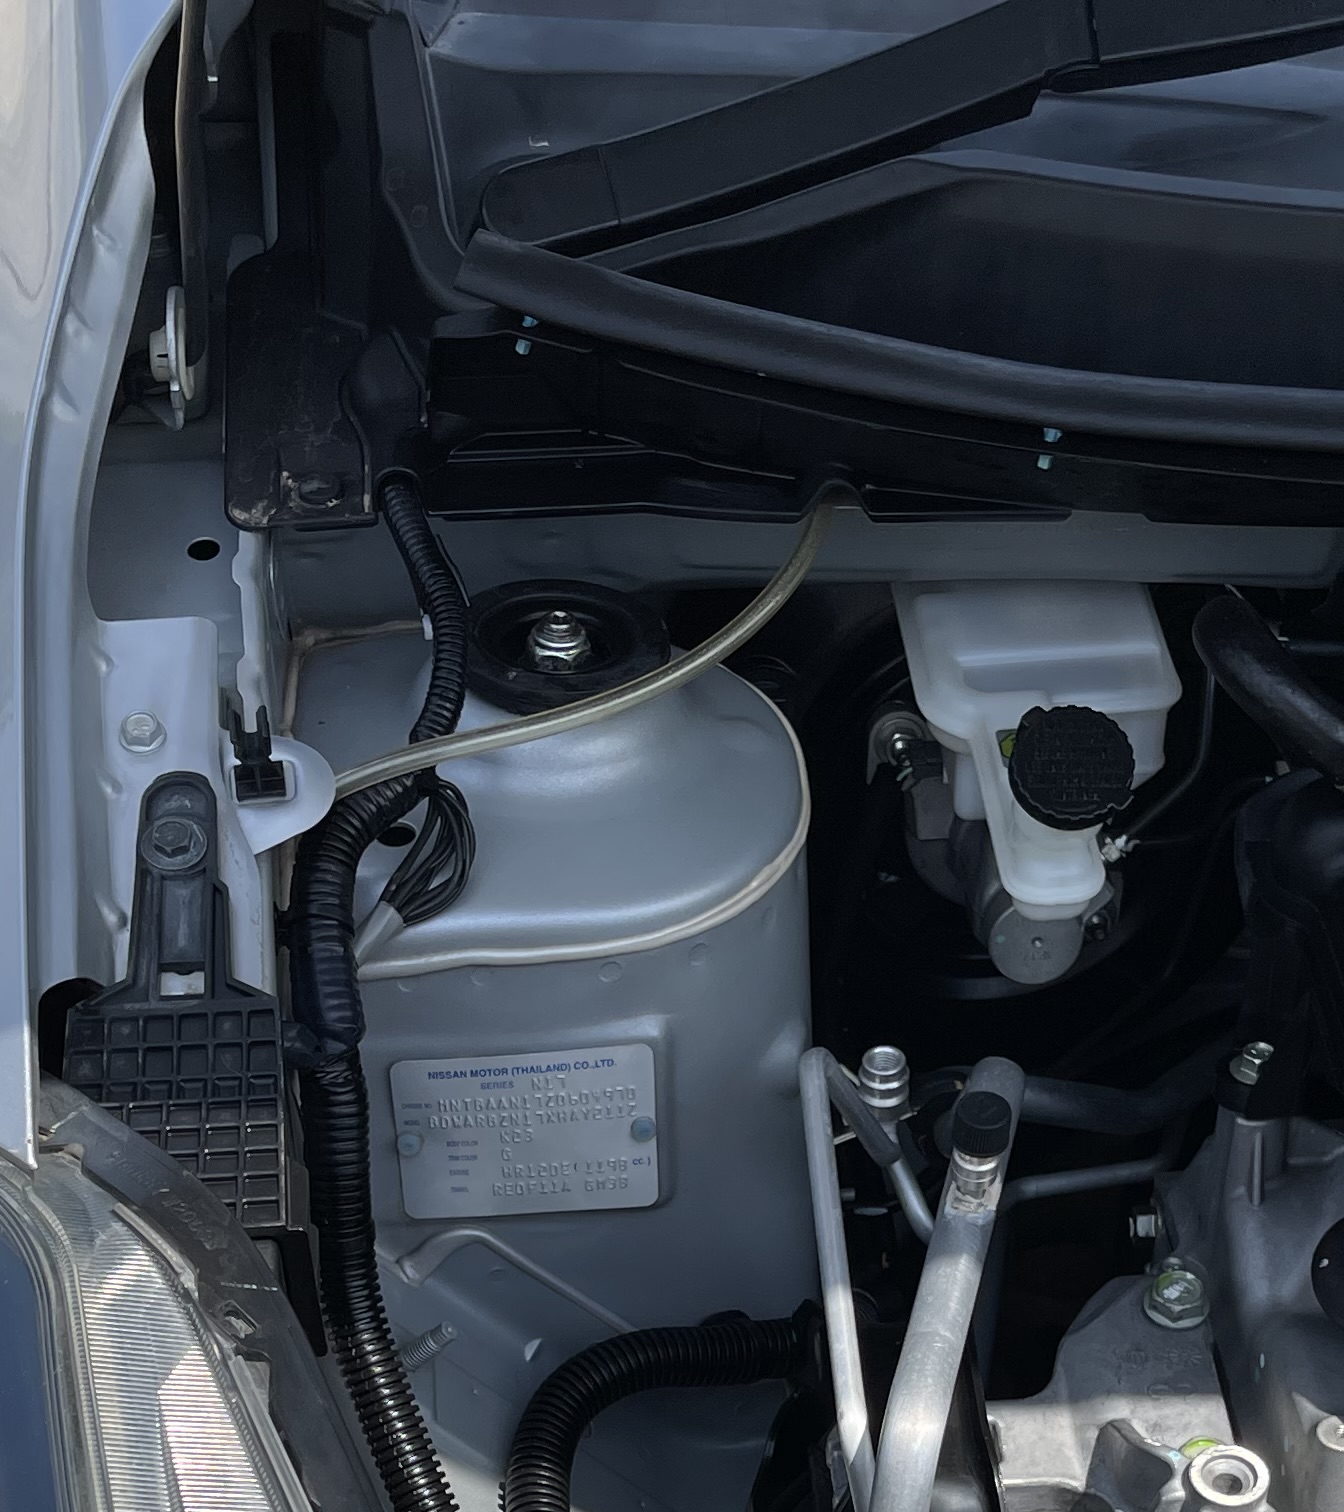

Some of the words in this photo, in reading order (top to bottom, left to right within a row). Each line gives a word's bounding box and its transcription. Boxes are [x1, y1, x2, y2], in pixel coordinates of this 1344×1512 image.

[428, 1069, 467, 1080] NISSAN
[470, 1067, 508, 1078] MOTOR
[511, 1063, 571, 1077] (THAILAND)
[480, 1081, 514, 1090] SERIES
[531, 1074, 566, 1091] N17
[500, 1128, 534, 1144] K23
